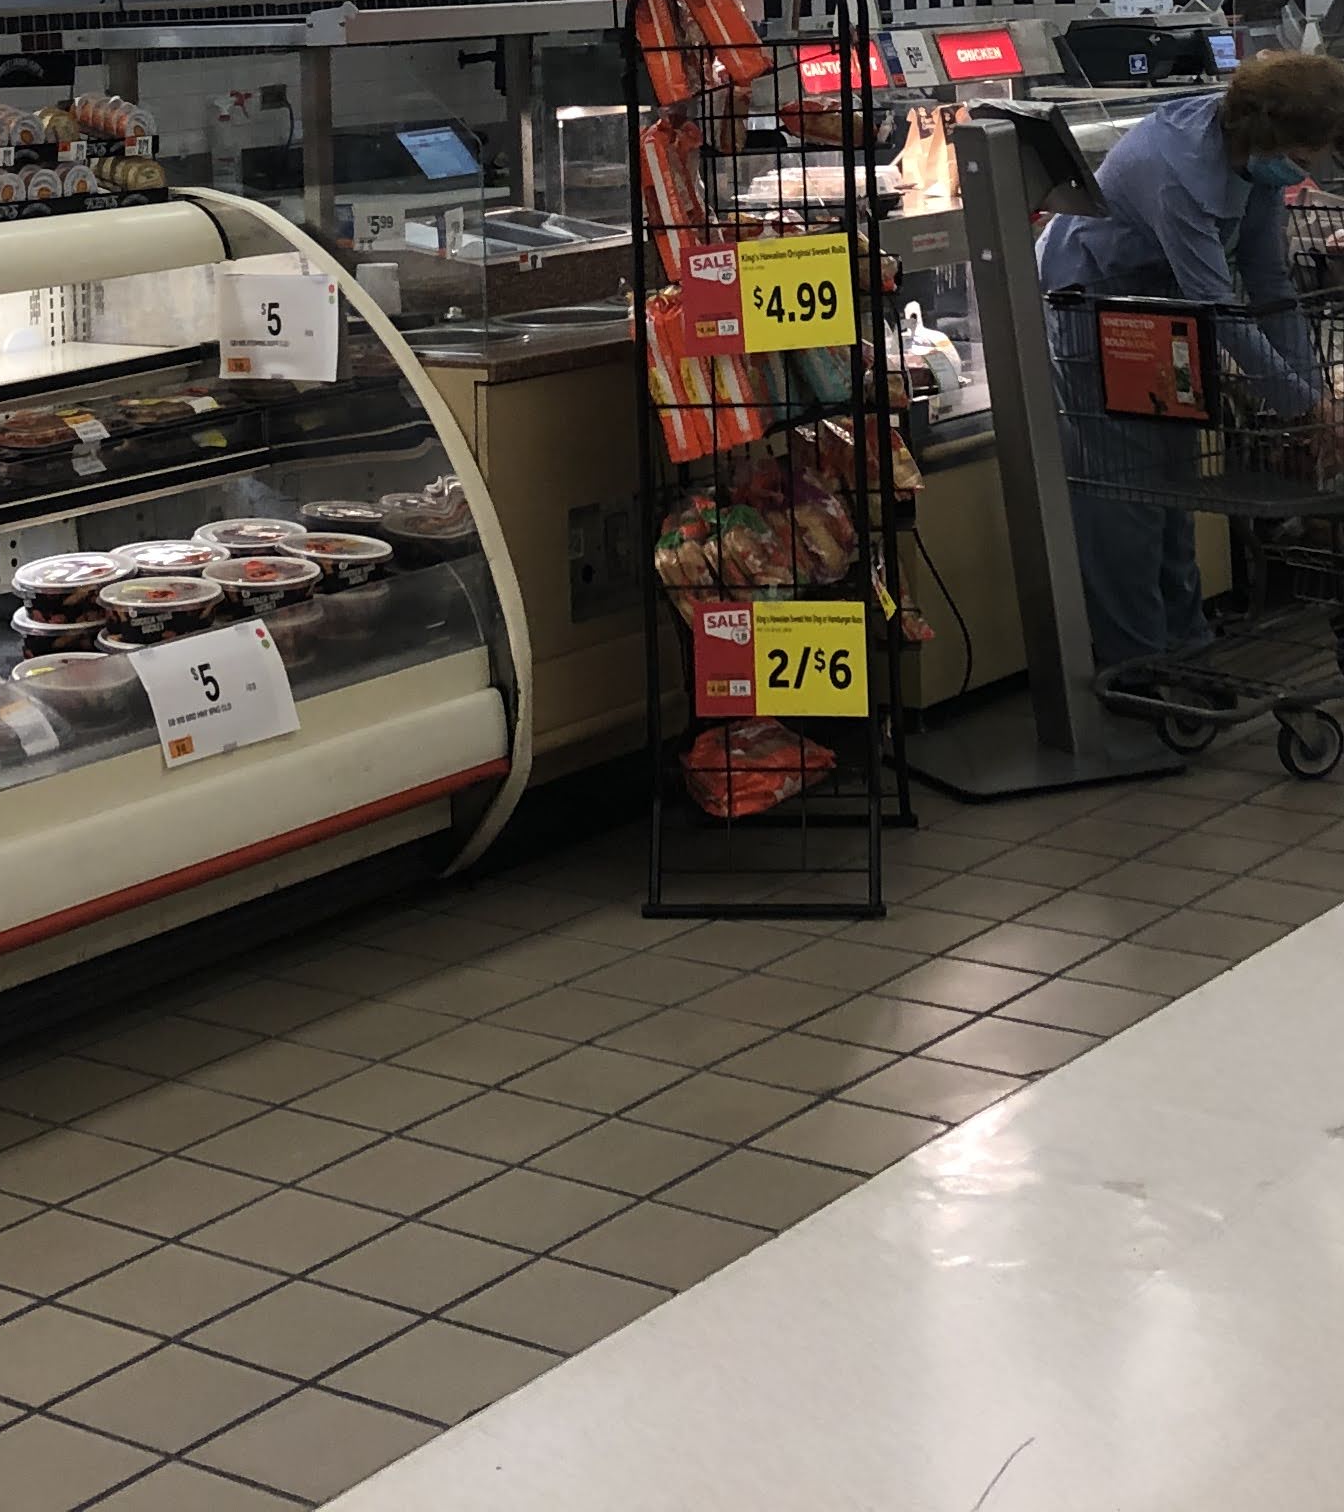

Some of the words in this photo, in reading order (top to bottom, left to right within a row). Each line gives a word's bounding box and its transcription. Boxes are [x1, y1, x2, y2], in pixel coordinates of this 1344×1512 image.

[956, 46, 1002, 63] CHICKEN
[692, 253, 734, 272] SALE
[753, 280, 838, 323] $4.99
[260, 302, 282, 336] $5
[706, 613, 748, 629] SALE
[190, 662, 221, 702] $5
[767, 646, 852, 691] 2/$6
